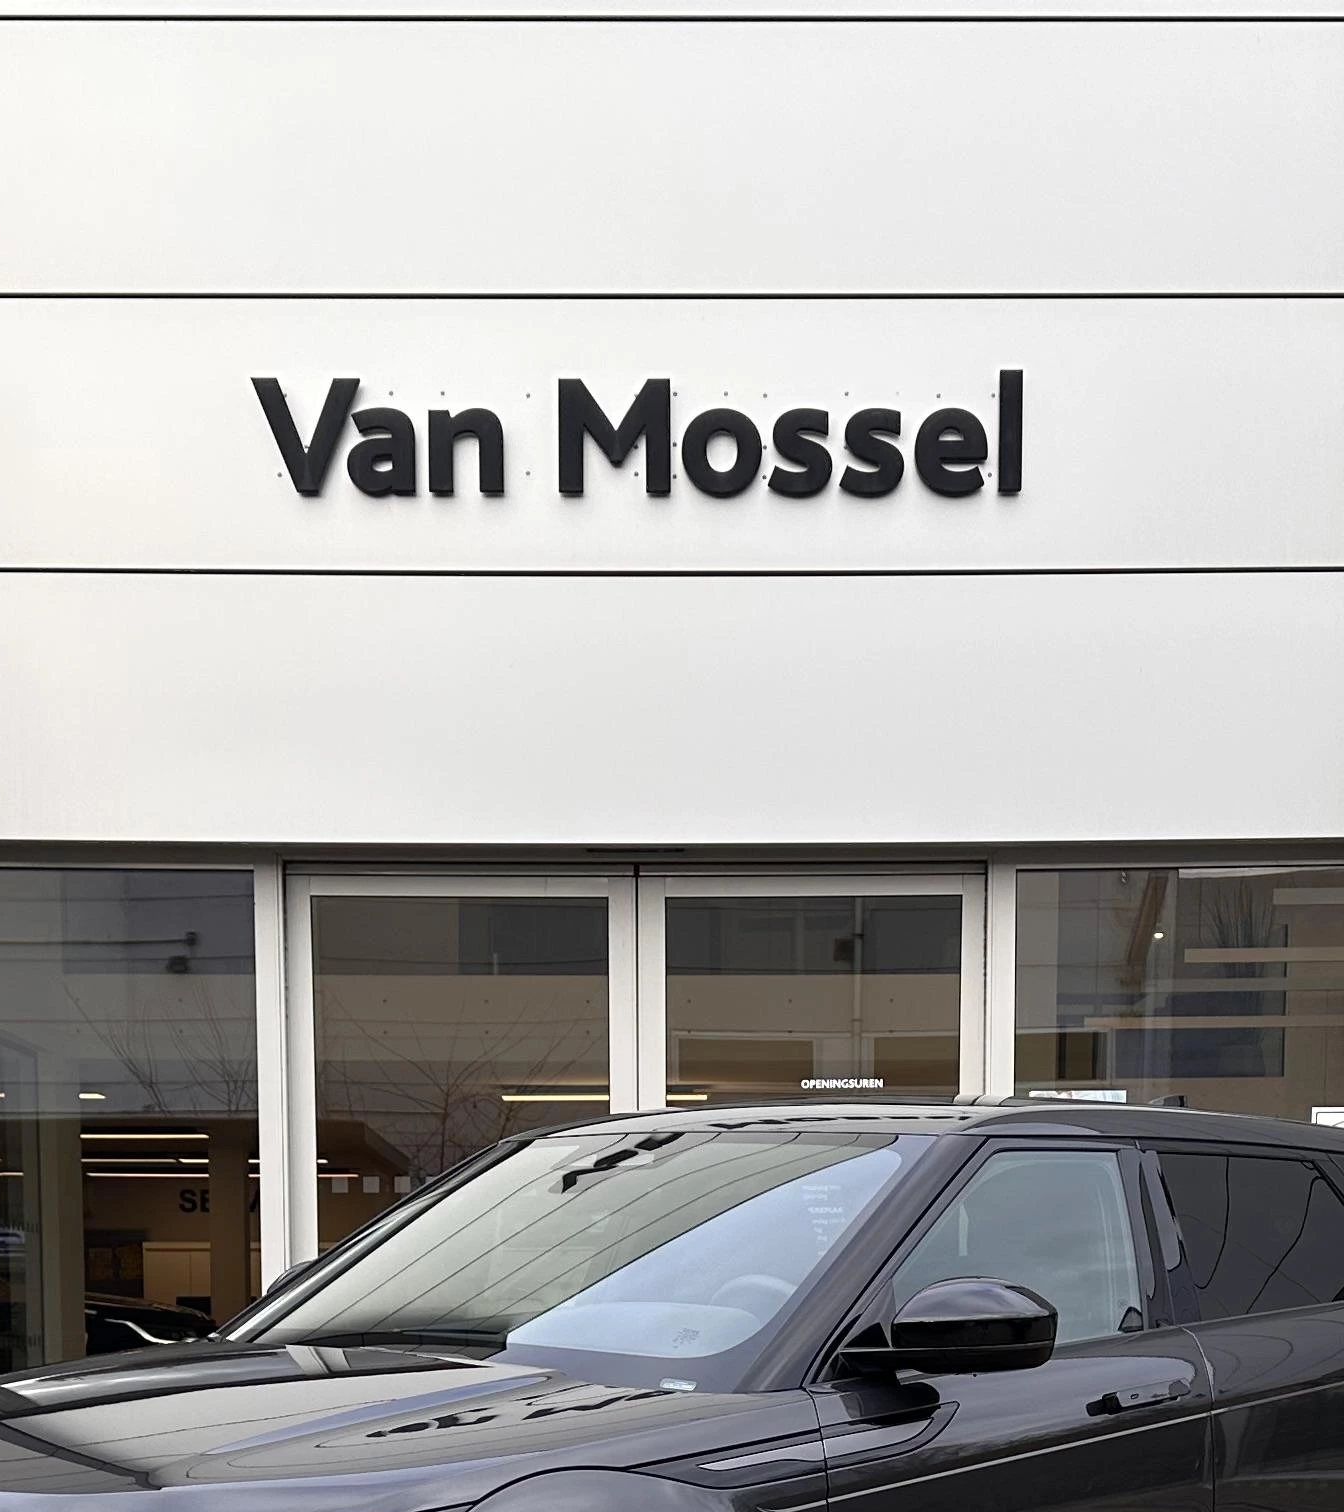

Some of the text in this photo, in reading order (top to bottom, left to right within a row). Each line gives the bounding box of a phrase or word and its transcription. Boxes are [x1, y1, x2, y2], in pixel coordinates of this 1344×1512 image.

[251, 369, 1023, 499] Van Mossel
[800, 1078, 885, 1090] OPENINGSUREN
